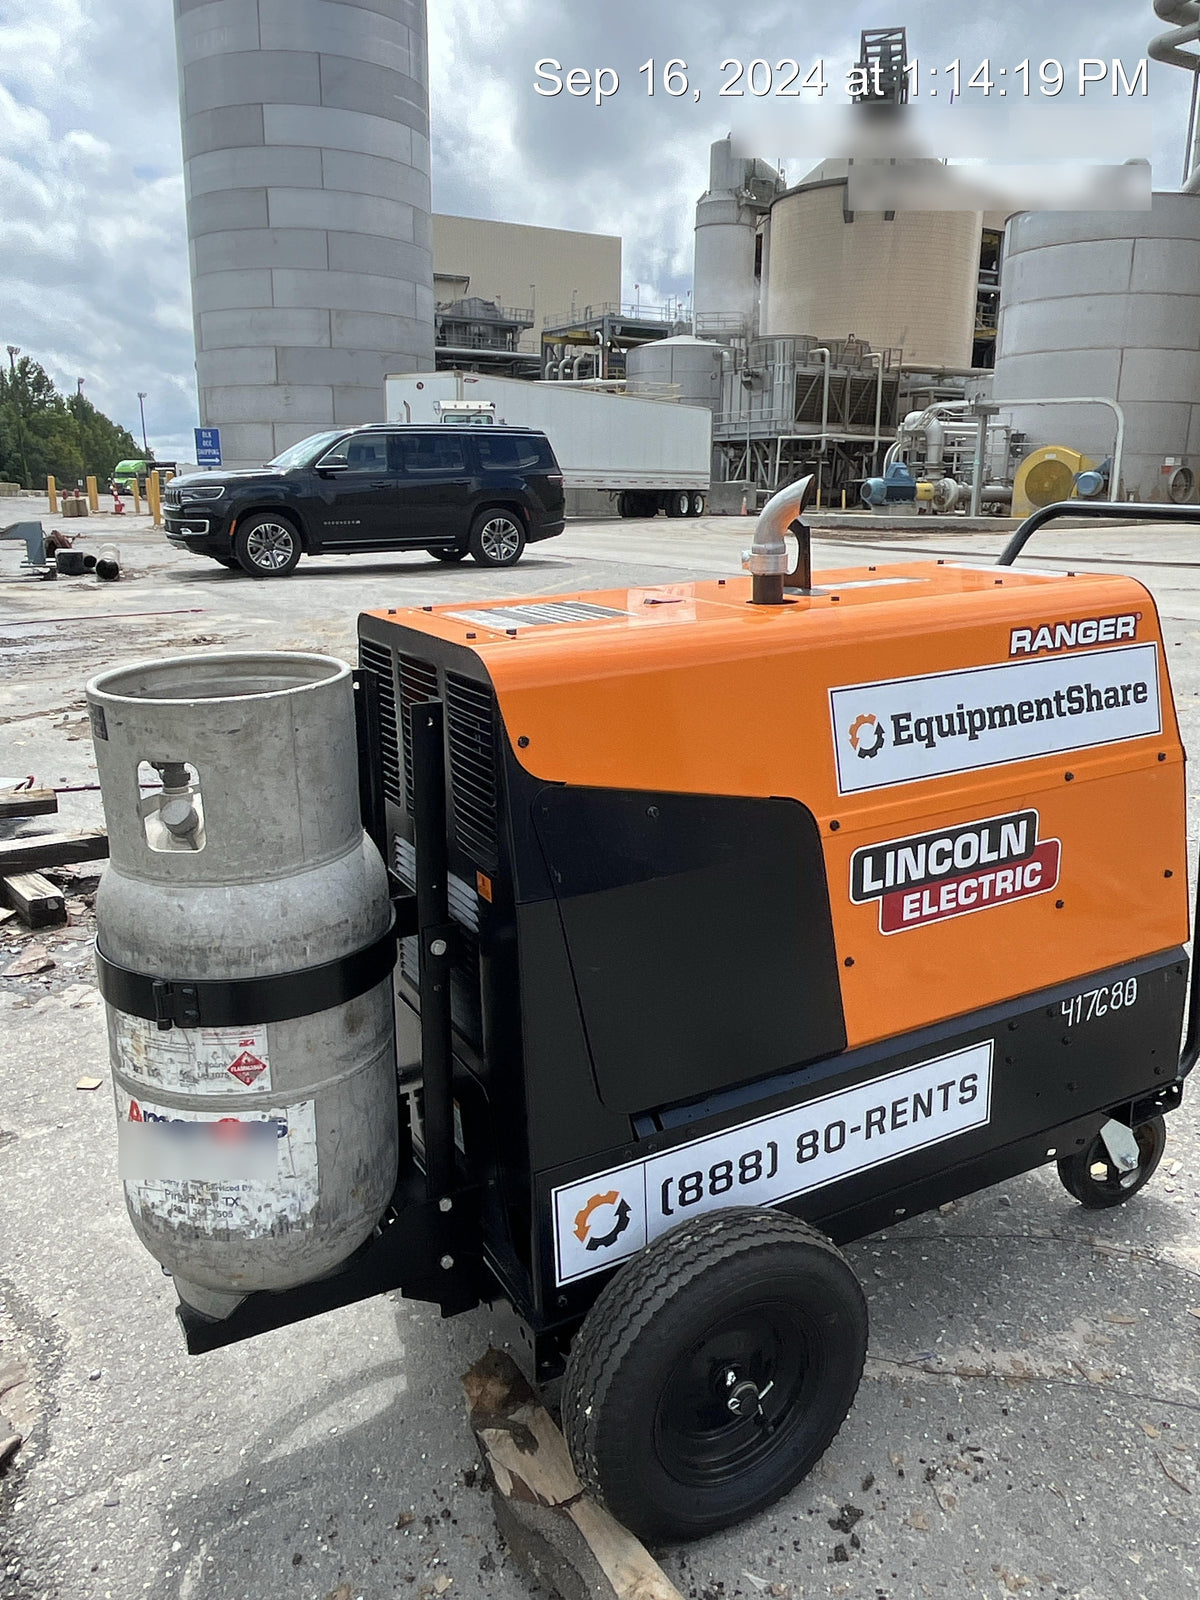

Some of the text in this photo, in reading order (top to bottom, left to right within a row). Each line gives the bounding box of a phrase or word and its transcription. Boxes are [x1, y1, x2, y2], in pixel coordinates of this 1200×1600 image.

[889, 680, 1149, 749] EquipmentShare
[862, 819, 1028, 894] LINCOLN
[902, 861, 1043, 921] ELECTRIC
[1061, 977, 1138, 1027] 417680
[660, 1072, 979, 1216] (888) 80-RENTS
[222, 1197, 242, 1207] TX
